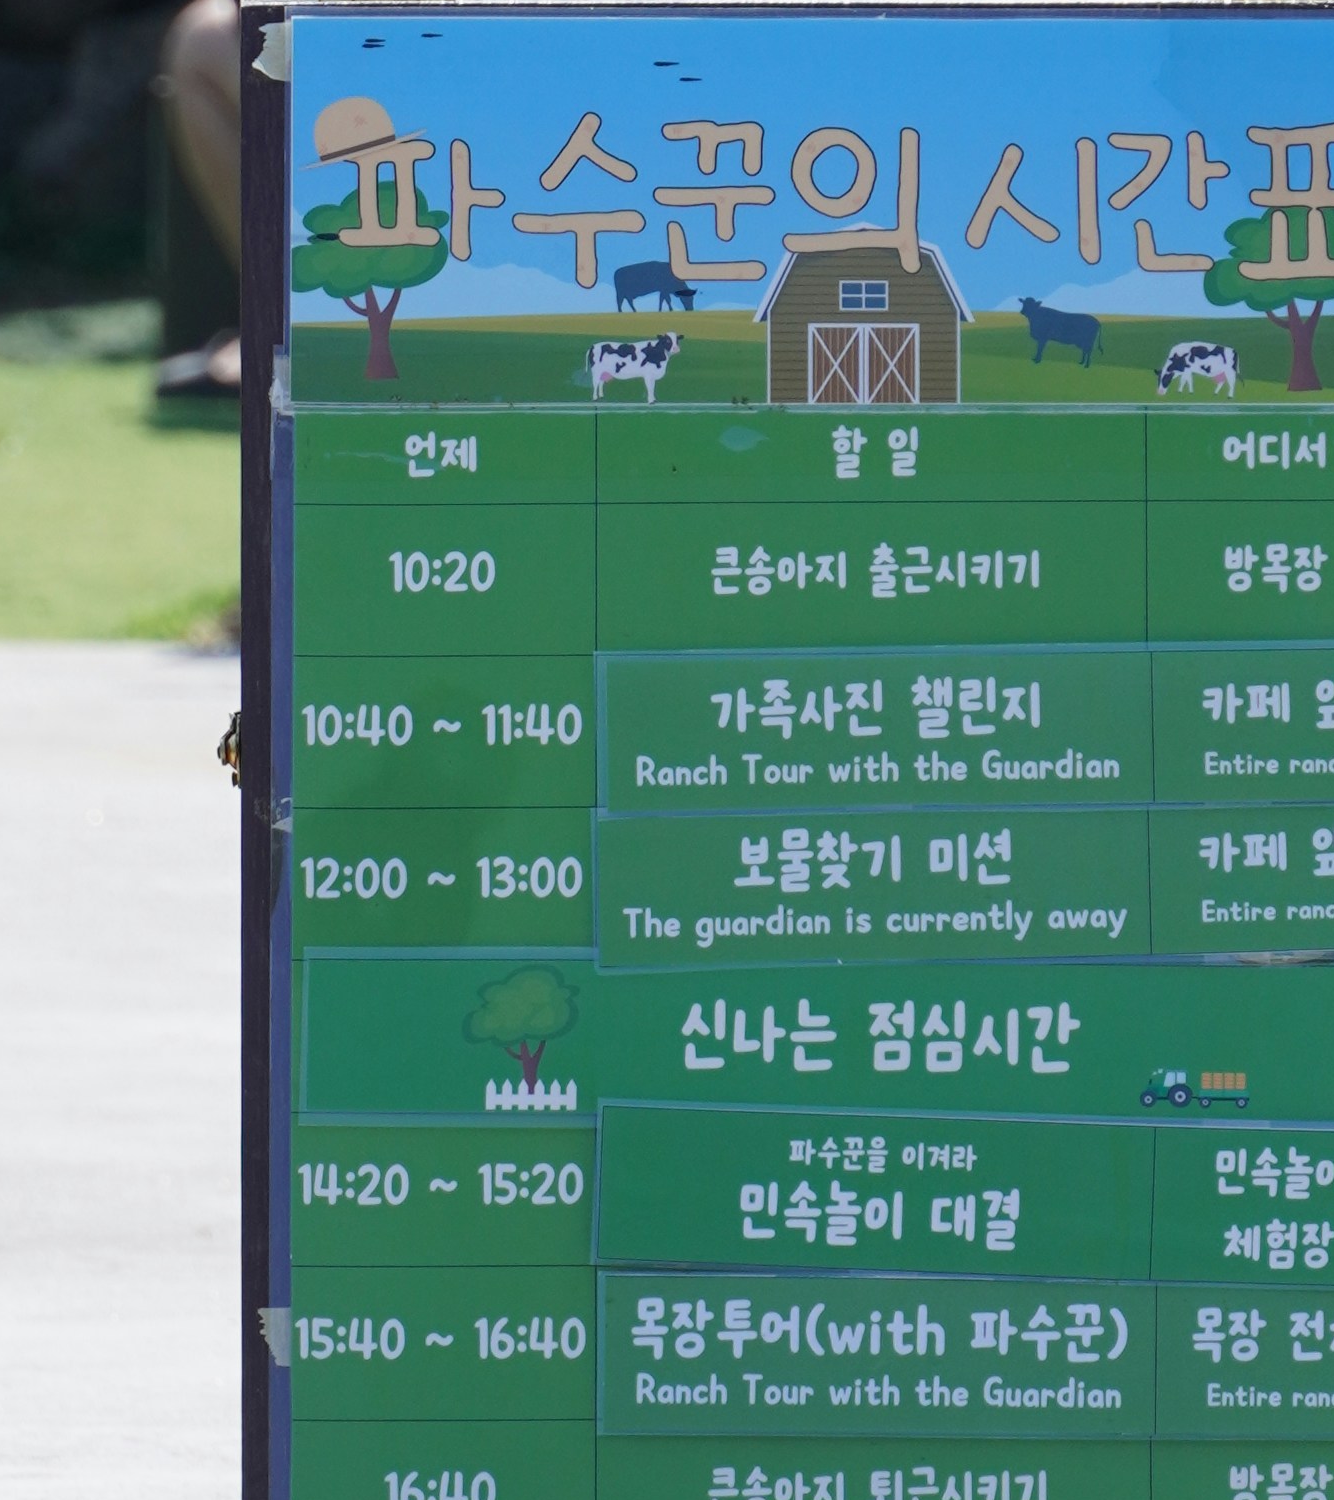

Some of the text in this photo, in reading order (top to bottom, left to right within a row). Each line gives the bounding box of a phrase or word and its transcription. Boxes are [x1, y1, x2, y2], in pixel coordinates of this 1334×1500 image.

[339, 113, 923, 290] 파수꾼의
[404, 431, 478, 478] 언제
[831, 424, 919, 479] 할 일
[1222, 431, 1327, 470] 어디서
[388, 550, 496, 593] 10:20
[710, 542, 1040, 599] 큰송아지 출근시키기
[1224, 543, 1329, 594] 방목장
[301, 704, 413, 747] 10:40
[481, 703, 583, 746] 11:40
[710, 674, 1041, 740] 가족사진 챌린지
[1202, 682, 1291, 725] 카페
[635, 748, 1120, 787] Ranch Tour with the Guardian
[1204, 751, 1279, 776] Entire
[733, 827, 1012, 893] 보물찾기 미션
[1198, 831, 1288, 873] 카페
[299, 857, 408, 900] 12:00
[475, 855, 583, 899] 13:00
[622, 899, 1128, 949] The guardian is currently away
[1201, 899, 1277, 923] Entire
[681, 998, 1081, 1074] 신나는 점심시간
[788, 1136, 978, 1174] 파수꾼을 이겨라
[297, 1163, 410, 1206] 14:20
[477, 1162, 584, 1206] 15:20
[739, 1179, 1020, 1252] 민속놀이 대결
[294, 1317, 406, 1361] 15:40
[474, 1316, 586, 1360] 16:40
[970, 1303, 1128, 1364] 파수꾼)
[1191, 1306, 1267, 1364] 목장
[635, 1372, 1122, 1409] Ranch Tour with the Guardian
[1207, 1382, 1282, 1408] Entire
